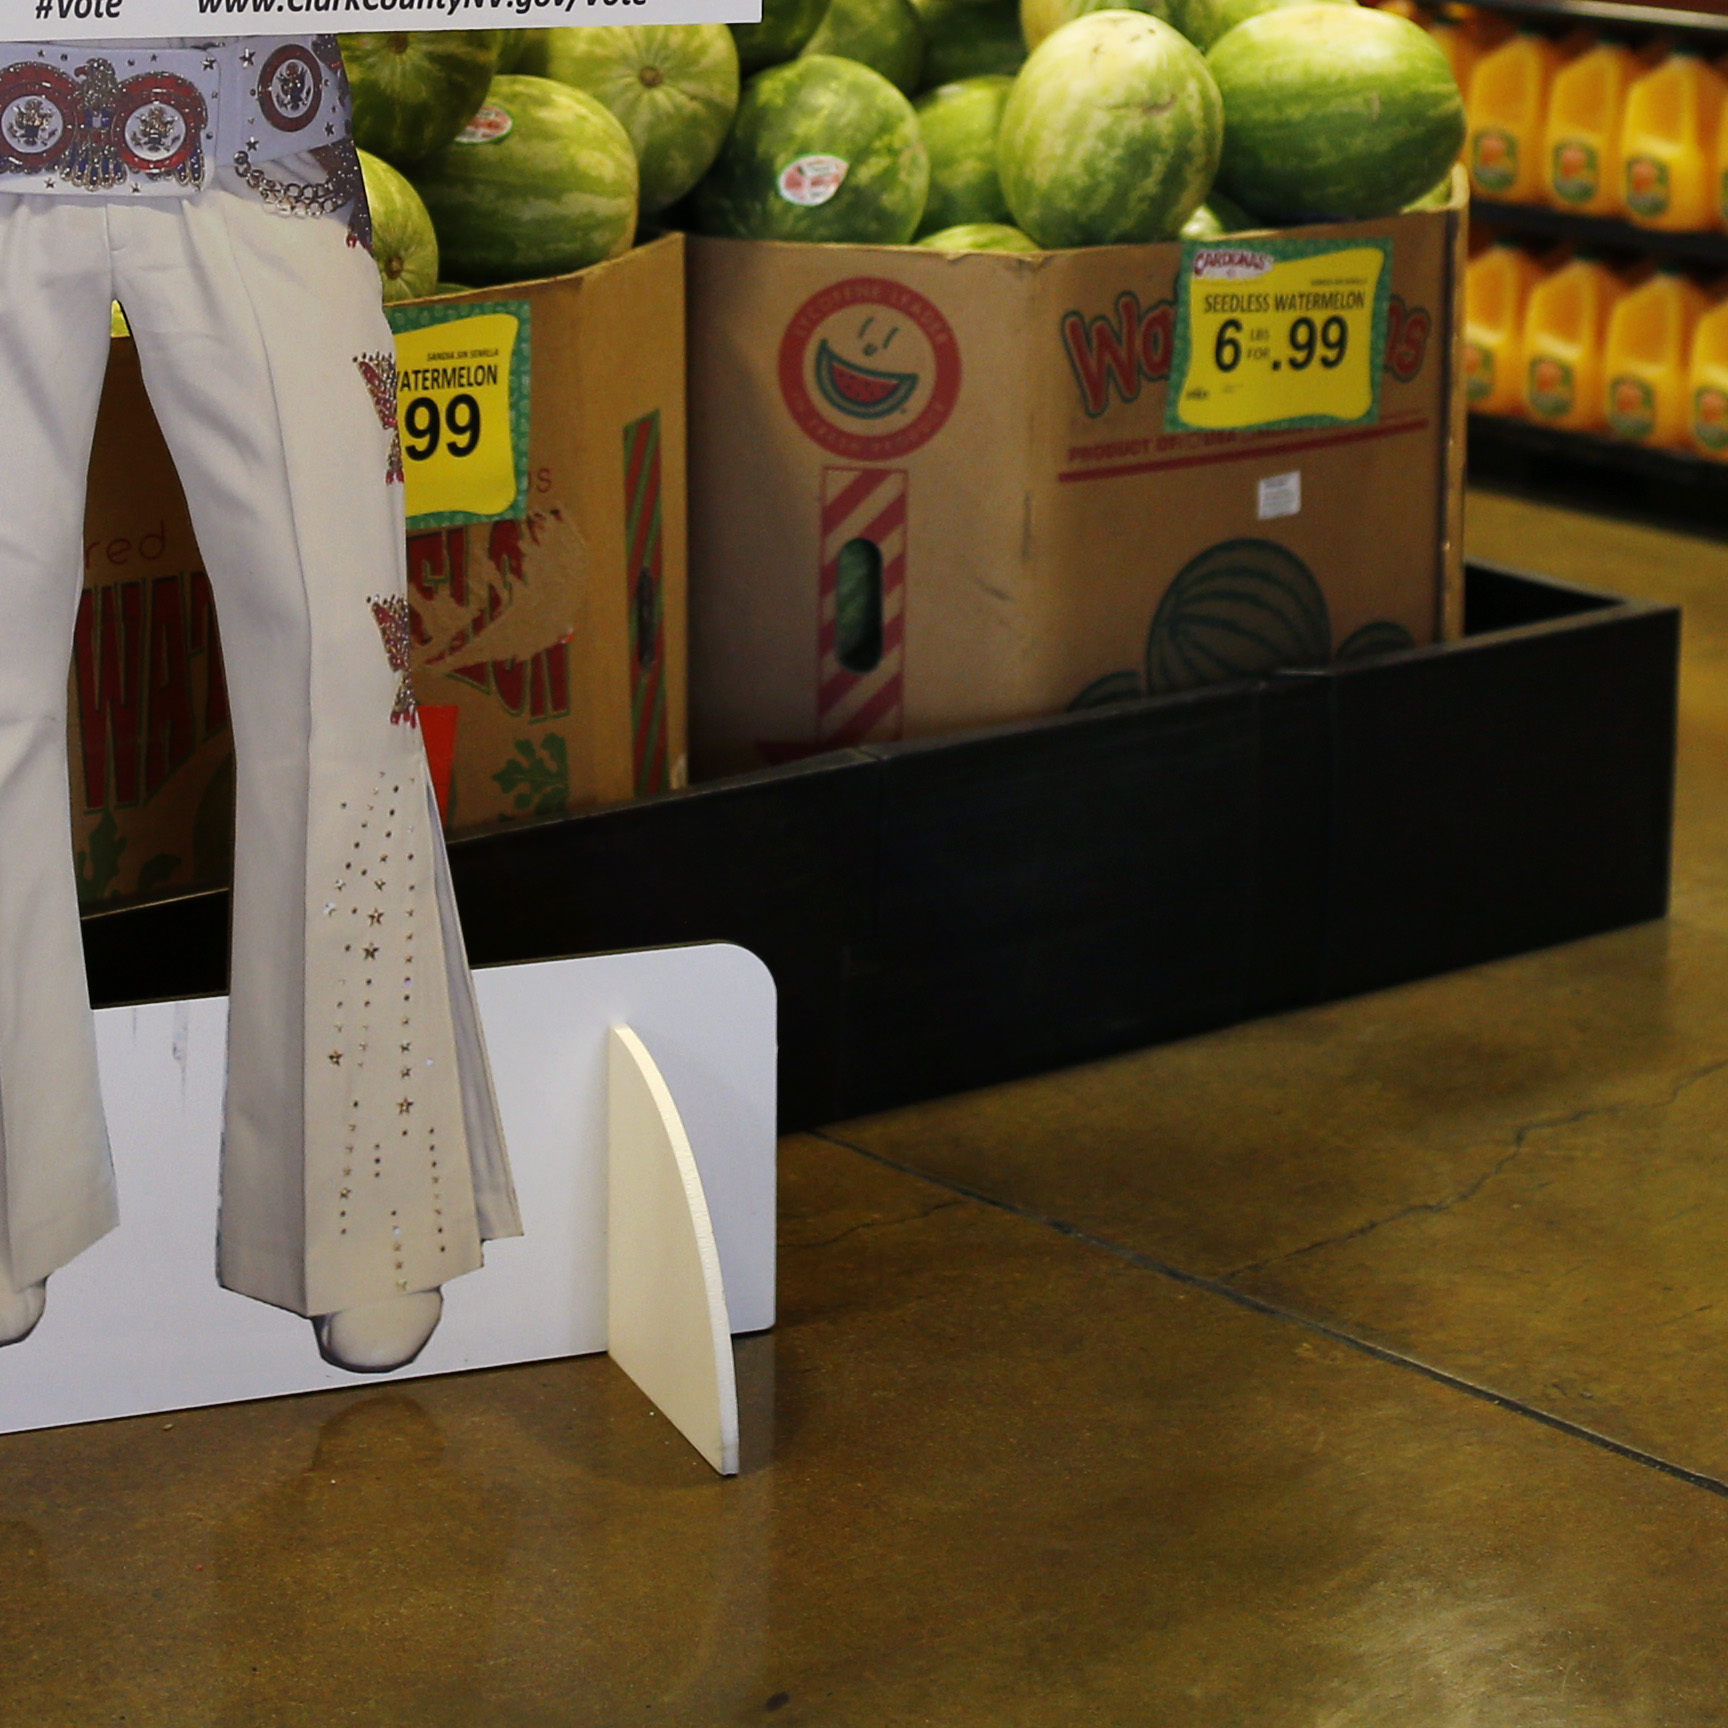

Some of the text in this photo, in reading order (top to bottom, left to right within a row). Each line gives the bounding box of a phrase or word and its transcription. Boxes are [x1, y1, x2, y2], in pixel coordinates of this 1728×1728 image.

[1204, 290, 1367, 314] SEEDLESS WATERMELON
[1215, 317, 1244, 373] 6
